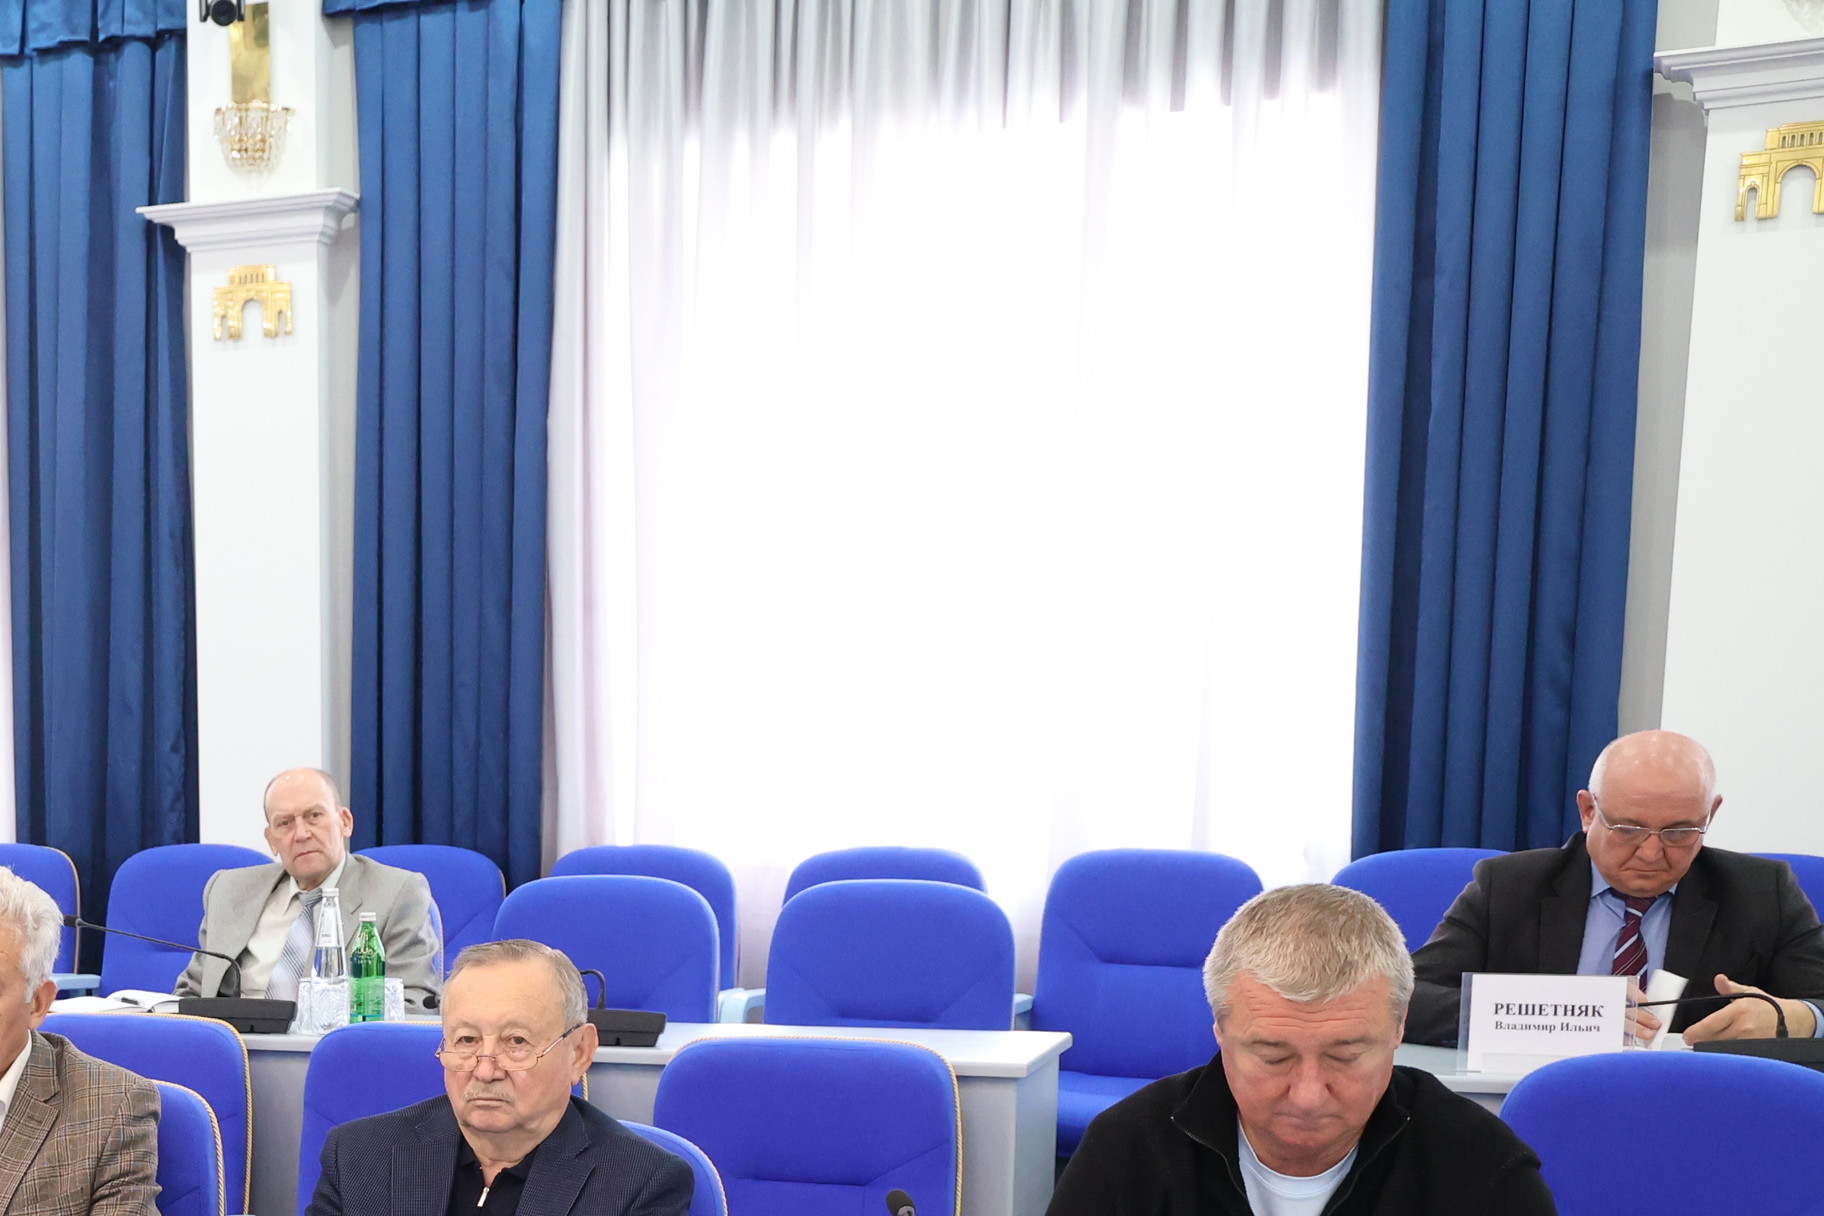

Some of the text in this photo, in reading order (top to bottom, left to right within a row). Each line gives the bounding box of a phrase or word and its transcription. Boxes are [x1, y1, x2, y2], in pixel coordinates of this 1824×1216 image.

[1494, 1002, 1604, 1018] РЕШЕТНЯК
[1494, 1020, 1600, 1034] Владимир Ильич
